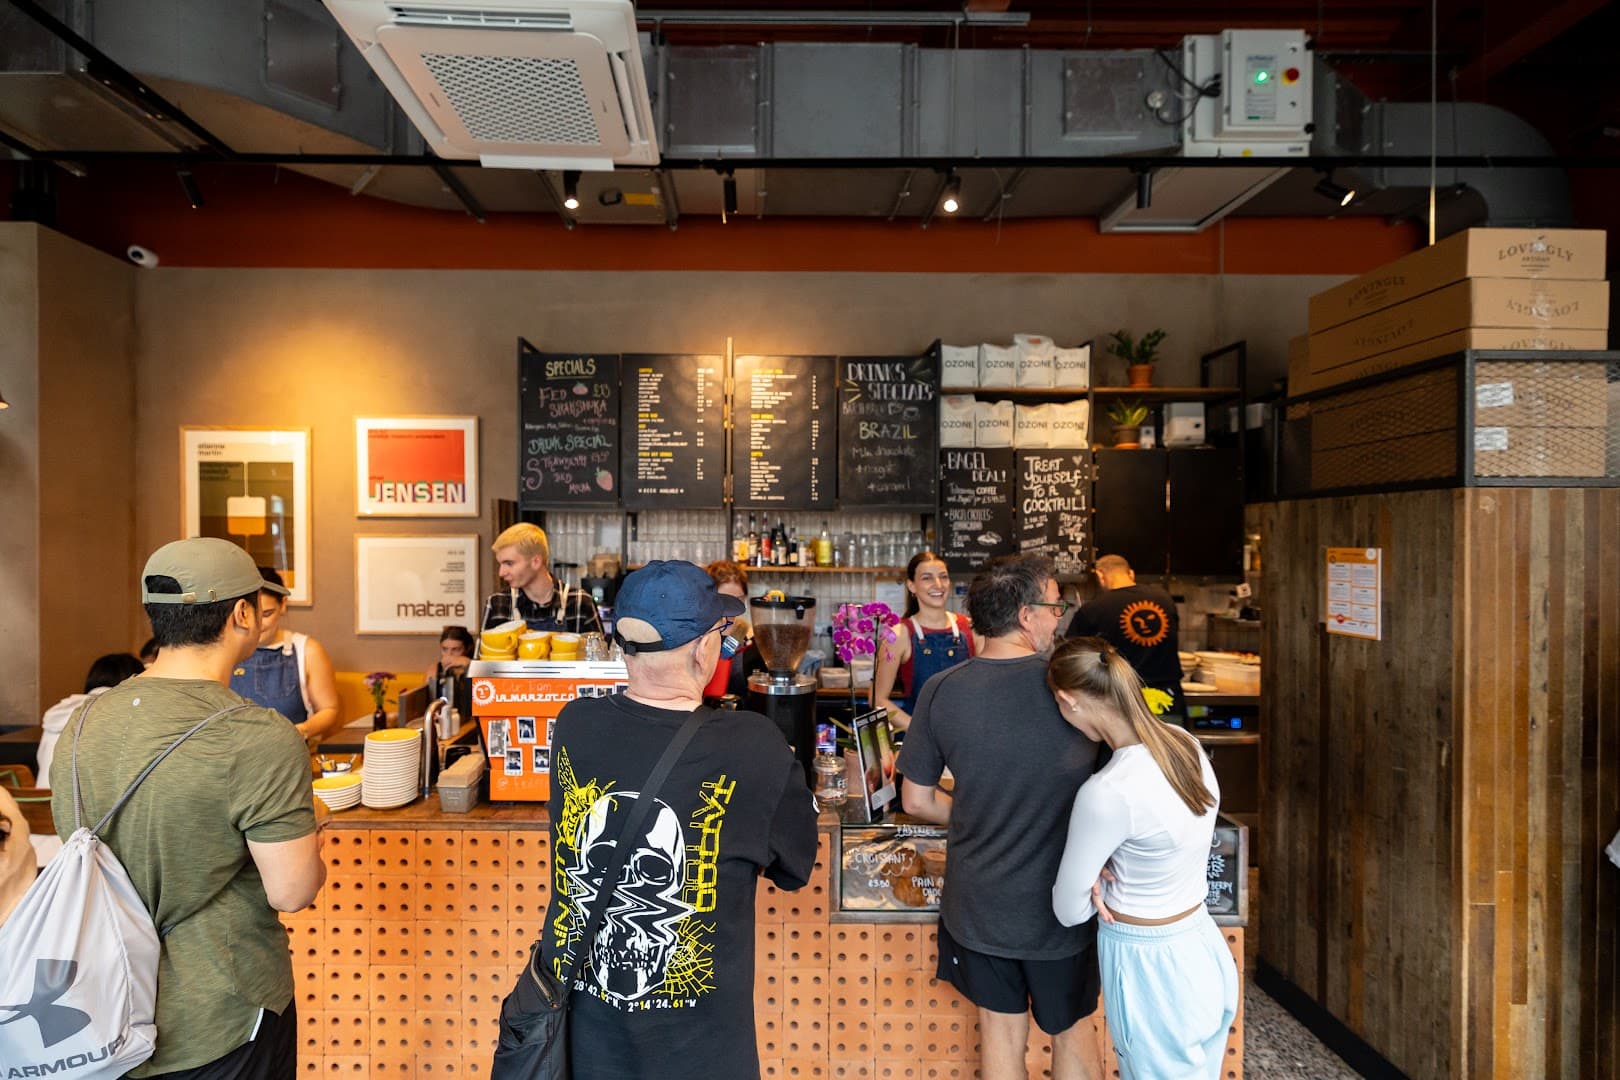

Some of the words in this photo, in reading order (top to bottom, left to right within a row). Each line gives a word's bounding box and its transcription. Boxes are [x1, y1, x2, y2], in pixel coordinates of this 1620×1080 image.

[545, 358, 597, 377] SPECIALS
[847, 362, 907, 381] DRINKS
[945, 360, 975, 368] OZONE
[986, 361, 1014, 369] OZONE
[1020, 360, 1051, 368] OZONE
[1055, 361, 1086, 369] OZONE
[867, 382, 934, 400] SPECIALS
[859, 421, 918, 439] BRAZIL
[943, 421, 972, 429] OZONE
[979, 420, 1009, 428] OZONE
[1018, 421, 1048, 429] OZONE
[1053, 421, 1085, 430] OZONE
[565, 434, 613, 451] SPECIAL
[948, 452, 990, 470] BAGEL
[1024, 455, 1064, 472] TREAT
[972, 470, 1006, 482] DEAL!
[1024, 470, 1082, 490] YOURSELF
[369, 480, 466, 503] JENSEN
[976, 486, 997, 495] COFFEE
[1032, 485, 1045, 498] TO
[1023, 495, 1086, 514] COCKTAIL!
[397, 600, 465, 617] mataré
[912, 876, 934, 887] PAIN
[7, 1034, 126, 1080] ARMOUR
